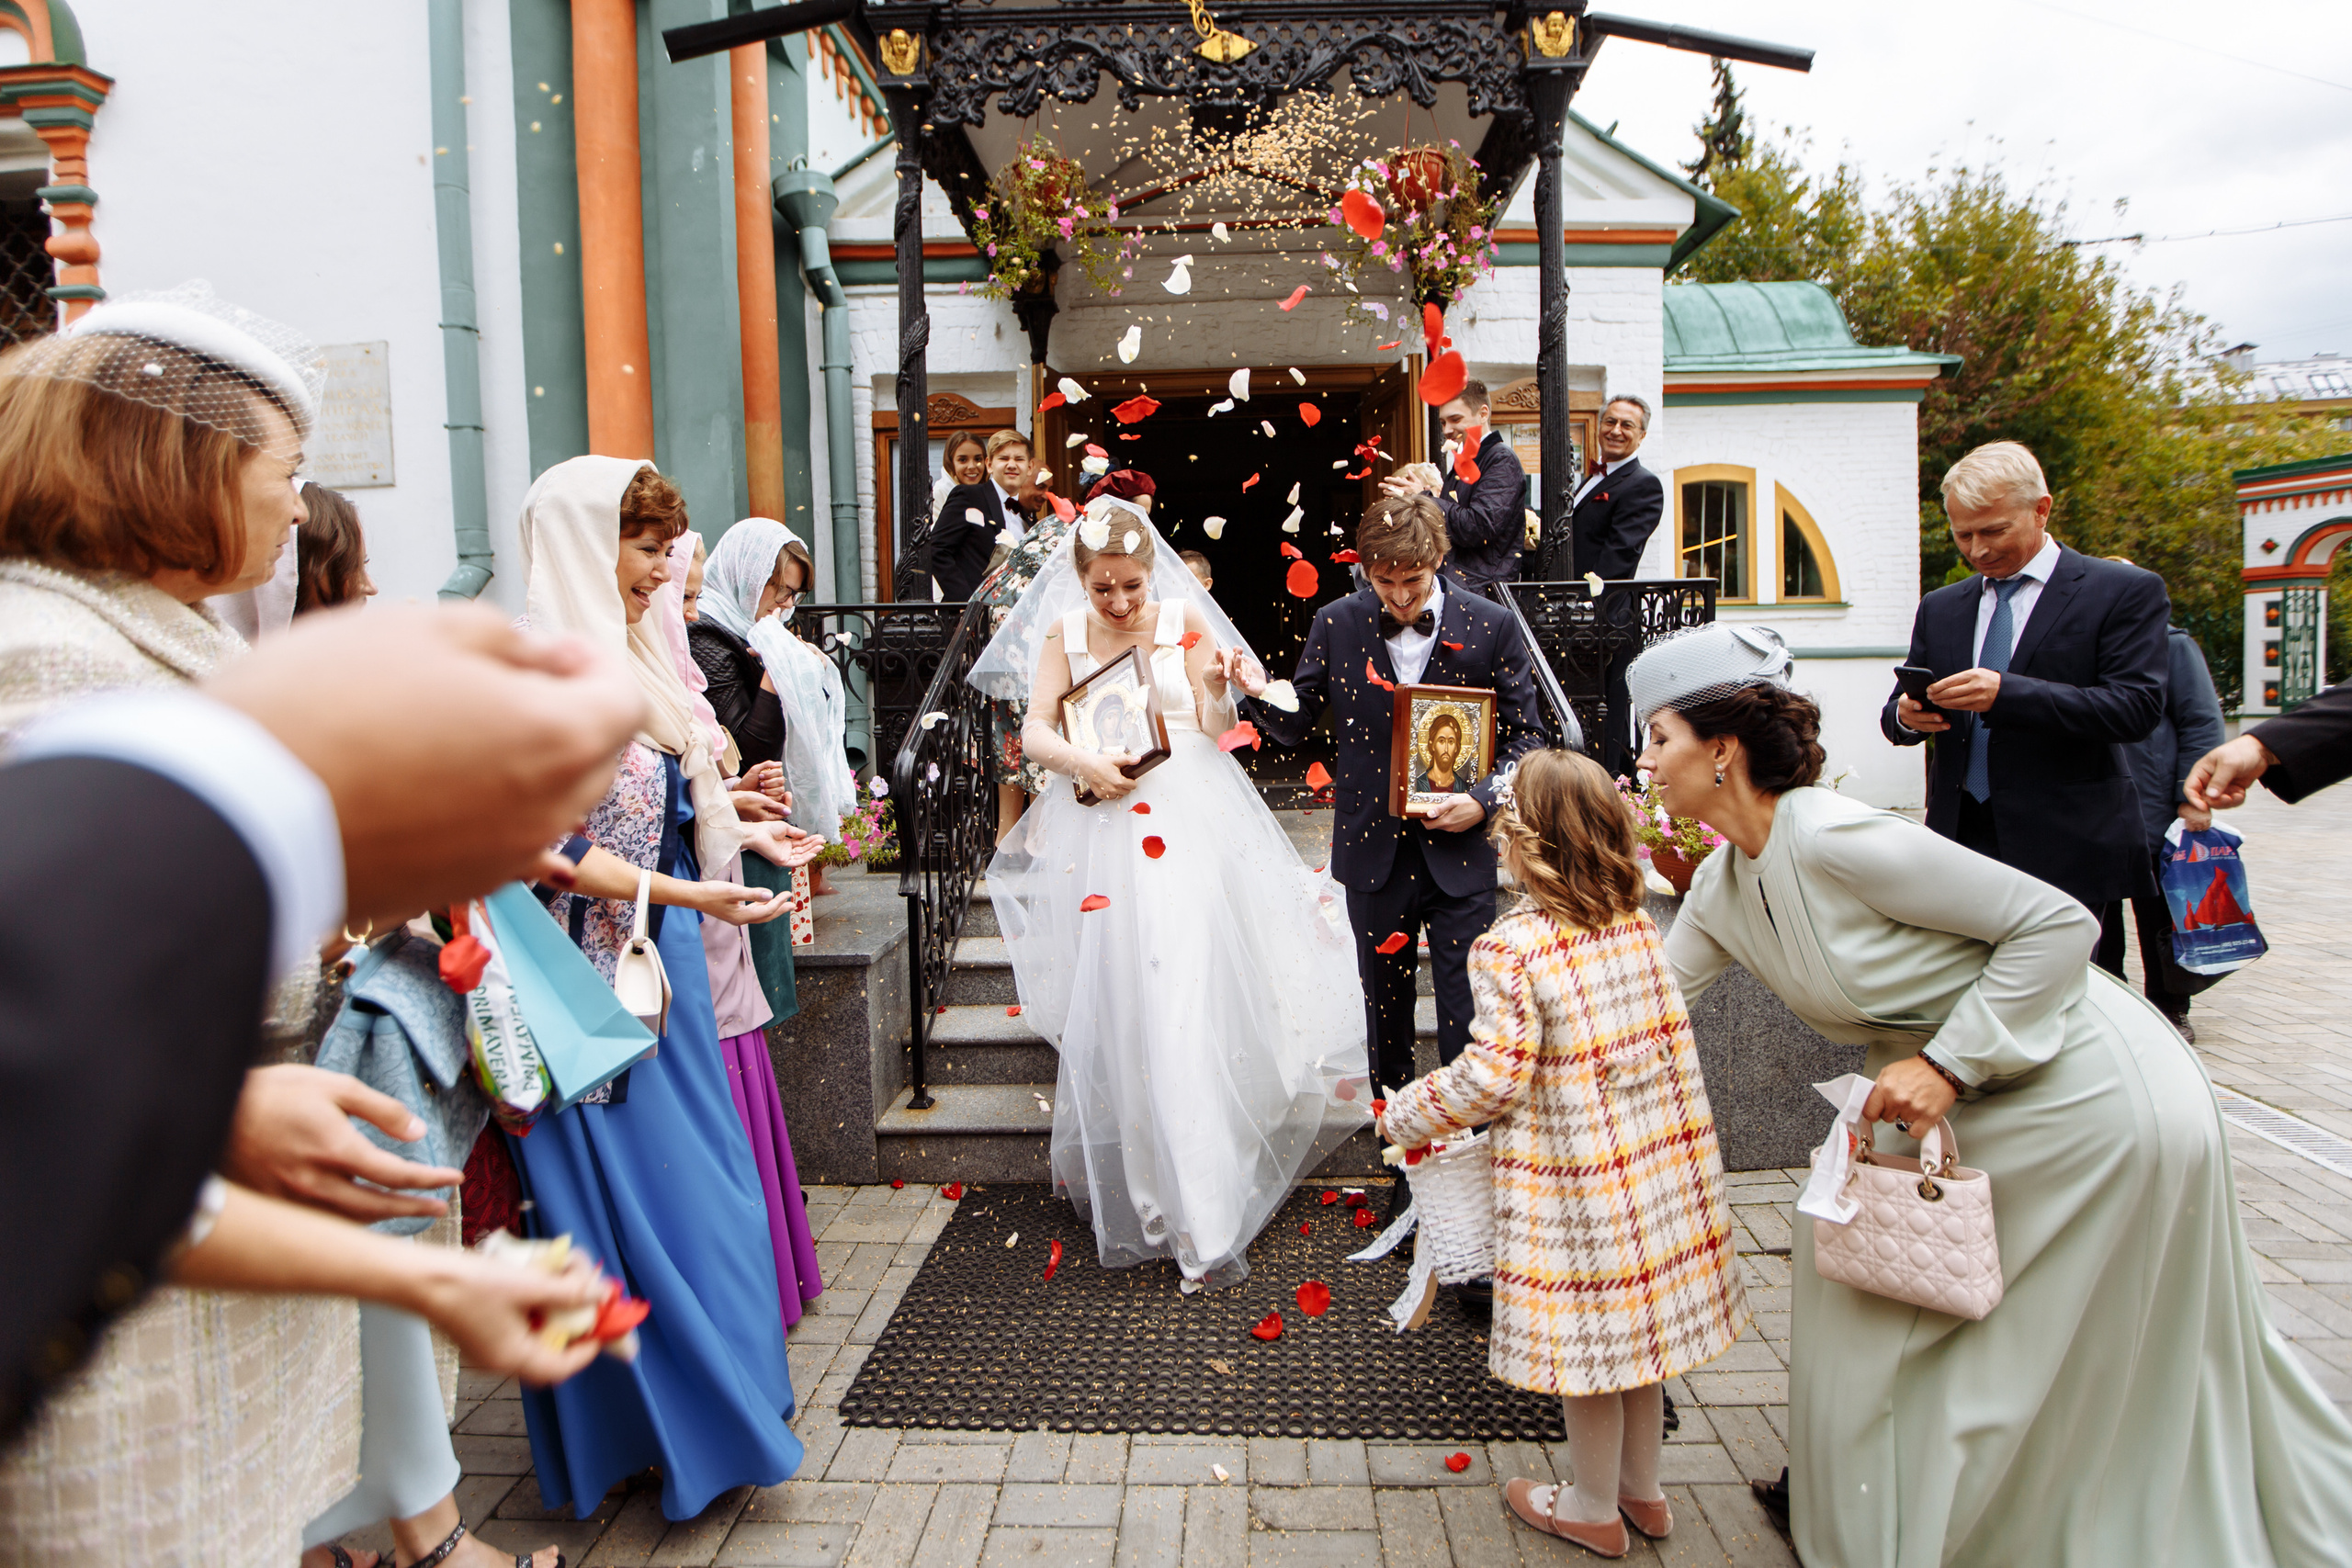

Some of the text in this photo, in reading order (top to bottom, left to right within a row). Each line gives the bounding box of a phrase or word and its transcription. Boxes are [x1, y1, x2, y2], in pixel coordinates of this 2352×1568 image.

[322, 402, 381, 416] НИКАХ
[2211, 846, 2235, 856] ПАР
[471, 985, 511, 1091] PRIMAVERA
